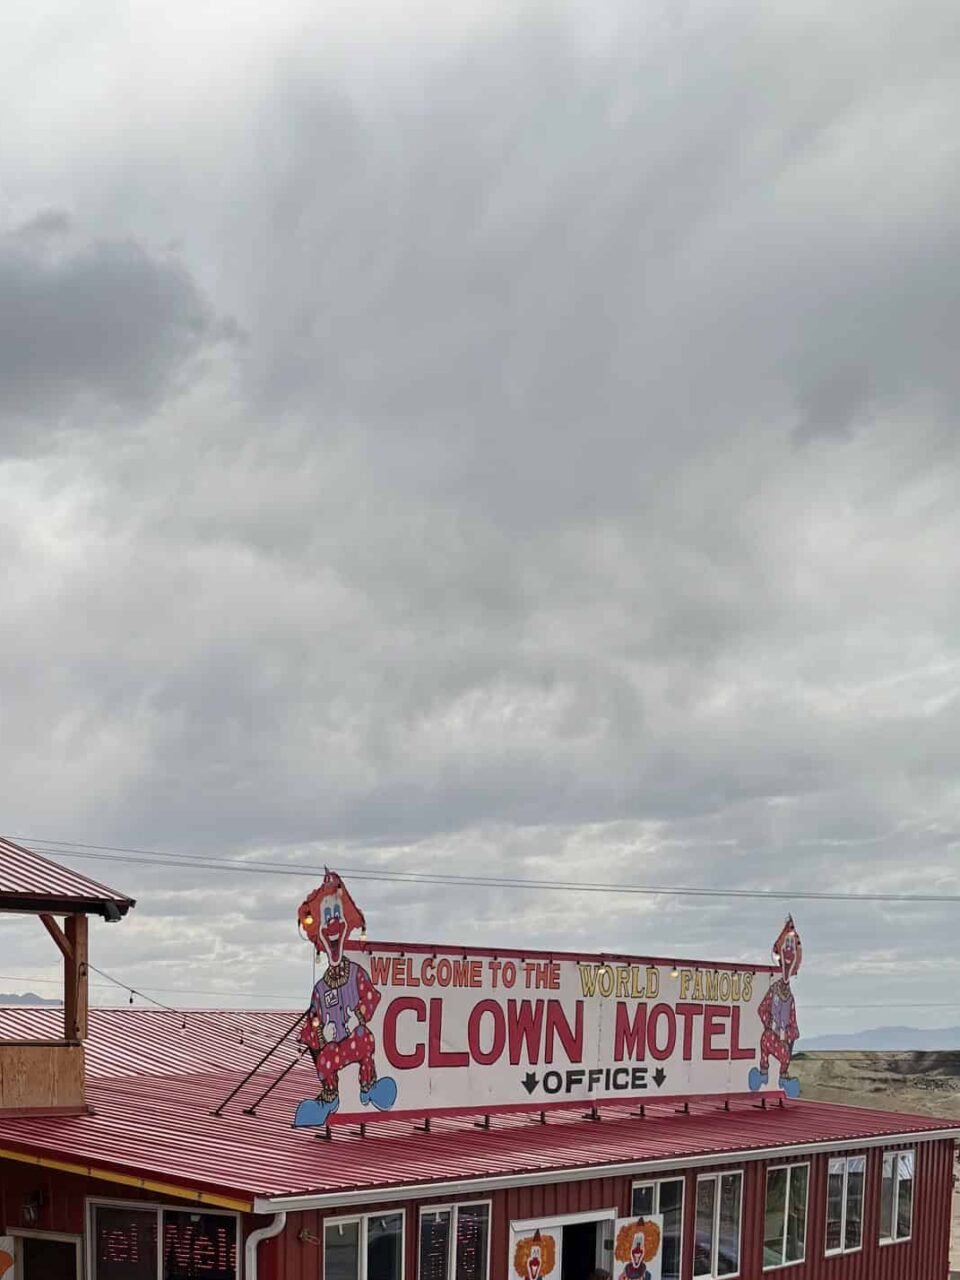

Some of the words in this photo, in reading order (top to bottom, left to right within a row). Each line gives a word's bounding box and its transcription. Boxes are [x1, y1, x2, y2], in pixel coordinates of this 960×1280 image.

[370, 957, 483, 987] WELCOME
[489, 961, 517, 989] TO
[523, 963, 561, 990] THE
[579, 965, 660, 999] WORLD
[679, 969, 753, 1002] FAMOUS
[383, 996, 585, 1070] CLOWN
[614, 1001, 756, 1061] MOTEL
[543, 1067, 648, 1094] OFFICE
